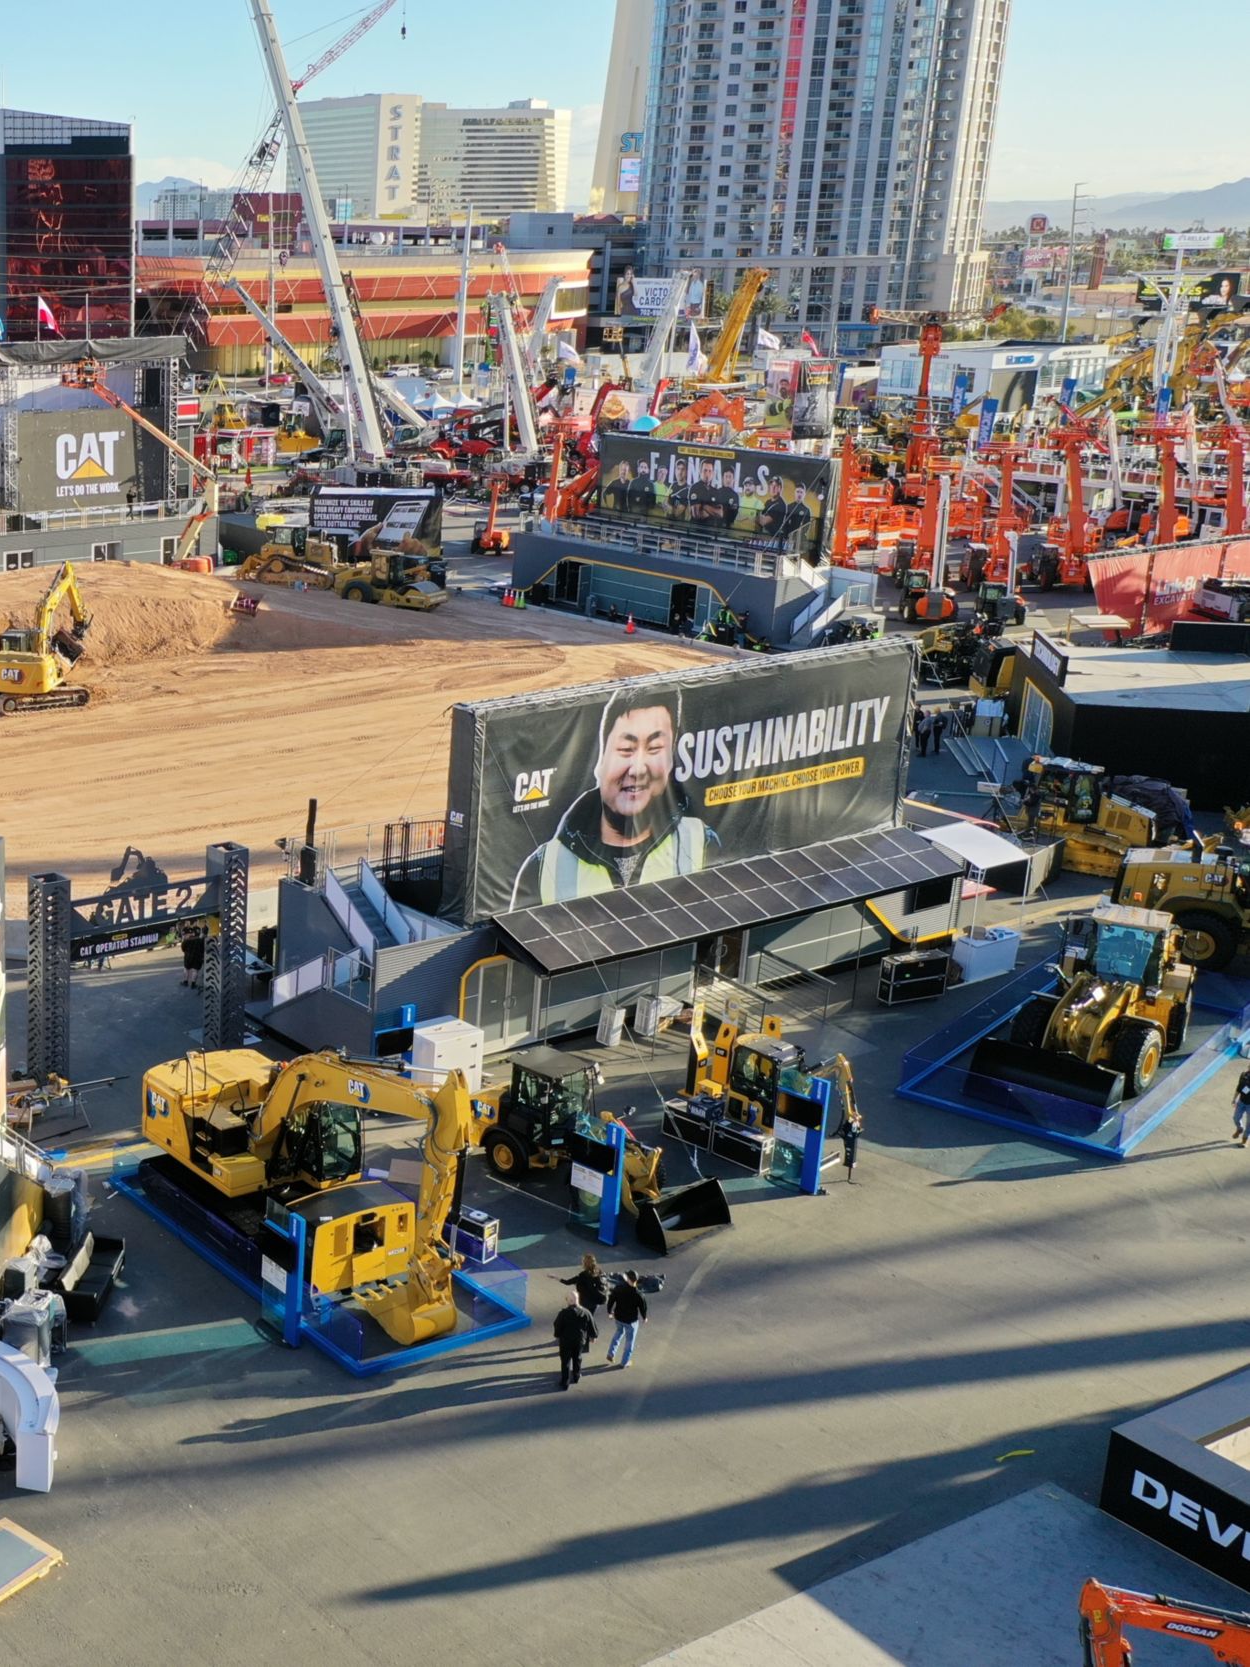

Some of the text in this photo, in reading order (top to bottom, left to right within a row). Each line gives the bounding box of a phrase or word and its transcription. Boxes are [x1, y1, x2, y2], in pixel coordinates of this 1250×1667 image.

[384, 105, 403, 201] STRAT
[645, 288, 668, 297] VICTO
[352, 393, 363, 422] GUAY
[56, 431, 119, 480] CAT
[56, 485, 75, 497] LET'S
[75, 485, 85, 496] DO
[86, 483, 98, 495] THE
[344, 506, 373, 514] EQUIPMENT
[1, 668, 20, 681] CAT
[674, 695, 891, 783] SUSTAINABILITY
[514, 768, 554, 802] CAT
[708, 762, 862, 801] CHOOSE YOUR MACHINE. CHOOSE YOUR POWER.
[450, 810, 464, 824] CAT
[1205, 873, 1224, 883] CAT
[90, 887, 192, 928] GATE 2
[80, 944, 93, 957] CAT
[95, 939, 129, 954] OPERATOR
[130, 933, 159, 947] STADIUM
[348, 1079, 365, 1098] CAT
[151, 1091, 166, 1112] CAT
[476, 1101, 492, 1115] CAT
[1166, 1622, 1218, 1638] DOOSAN
